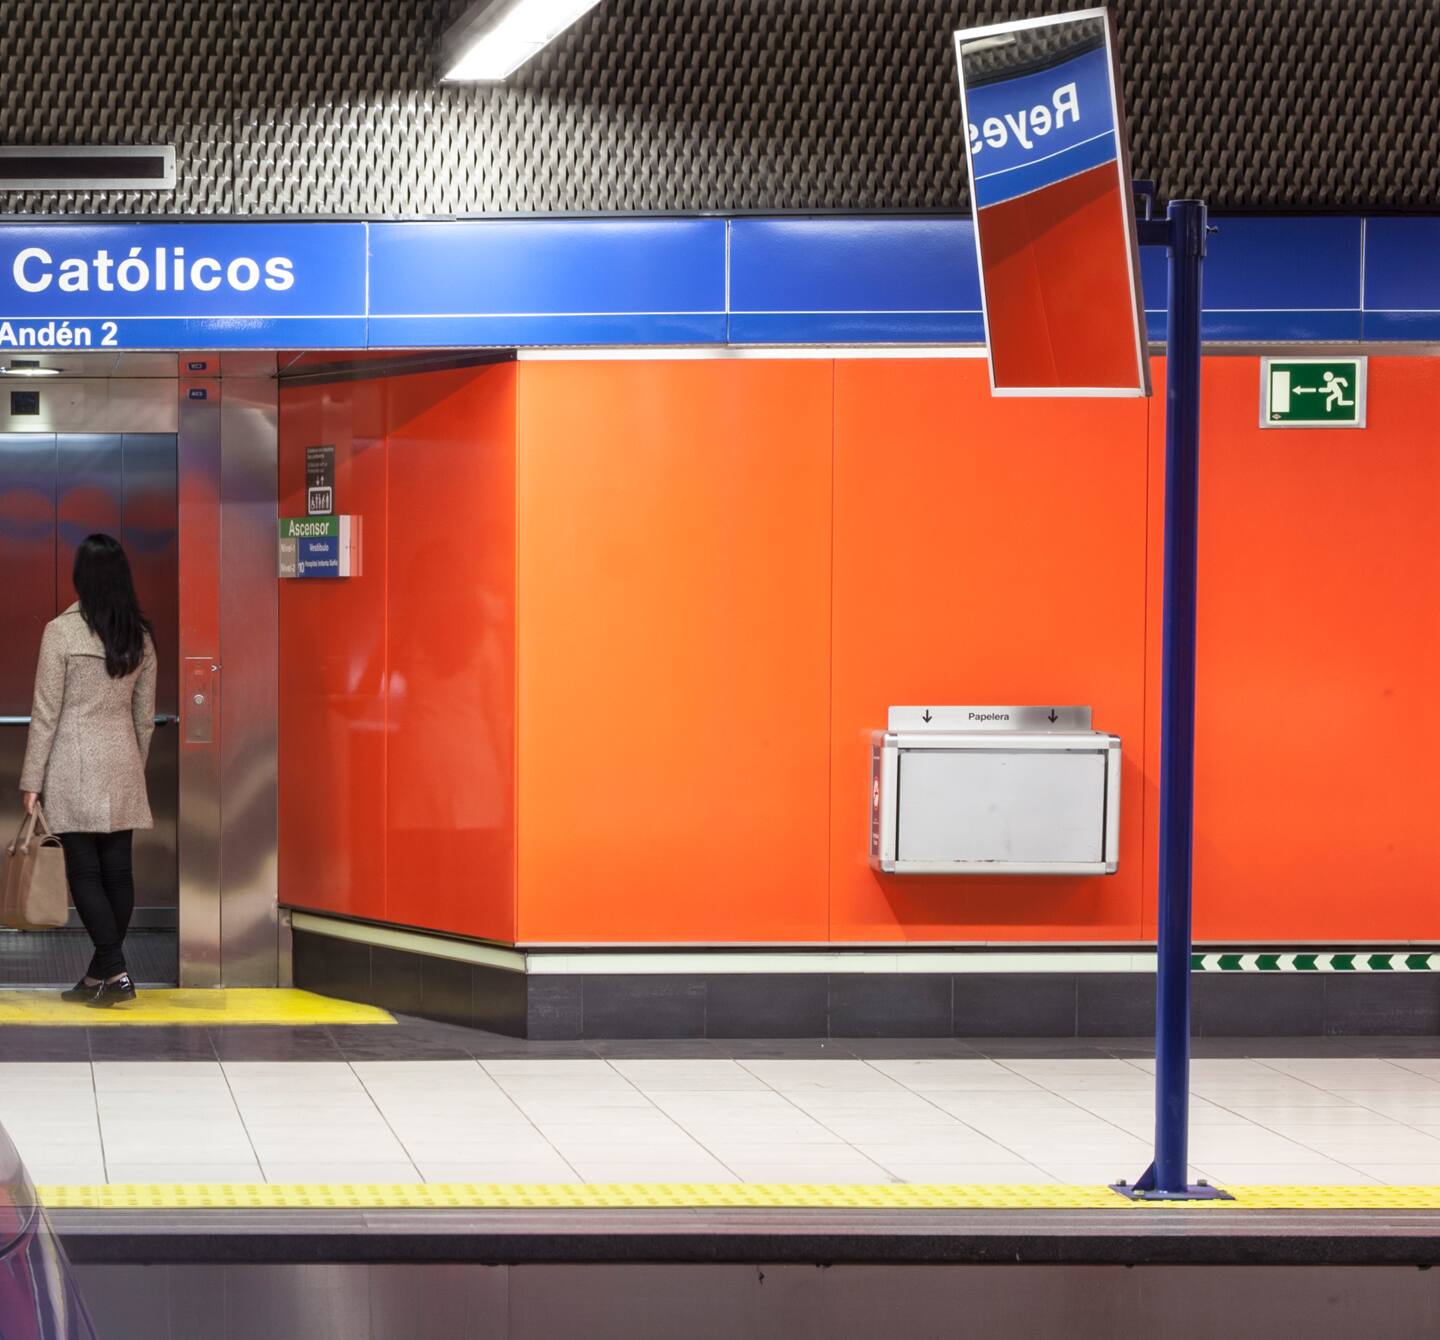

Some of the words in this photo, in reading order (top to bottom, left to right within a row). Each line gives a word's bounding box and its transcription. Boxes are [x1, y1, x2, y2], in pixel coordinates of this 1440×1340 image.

[12, 247, 294, 292] Católicos
[101, 322, 118, 346] 2
[288, 519, 330, 537] Ascensor
[968, 712, 1010, 723] Papelera
